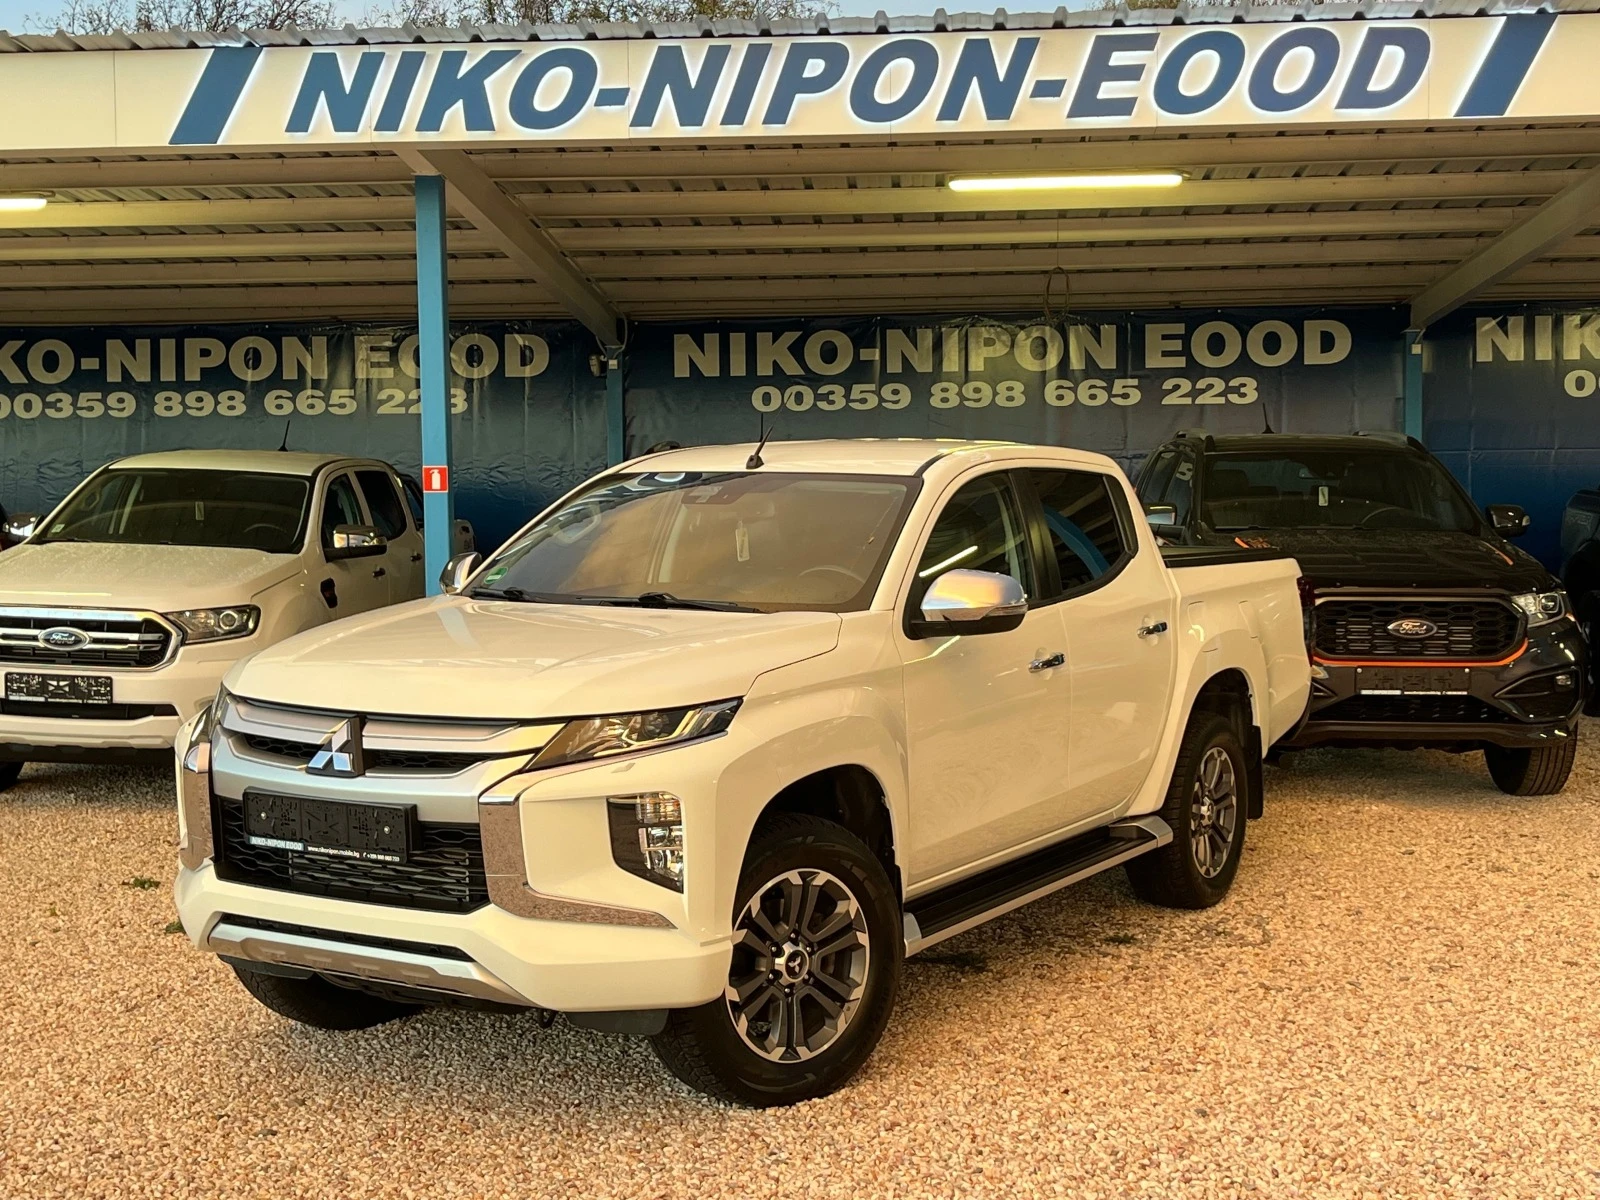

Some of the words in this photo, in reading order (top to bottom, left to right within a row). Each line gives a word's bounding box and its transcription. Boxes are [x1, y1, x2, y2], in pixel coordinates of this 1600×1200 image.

[285, 26, 1431, 133] NIKO-NIPON-EOOD
[673, 323, 1117, 378] NIKO-NIPON
[1144, 319, 1353, 369] EOOD
[1475, 313, 1600, 363] NIK
[153, 390, 247, 418] 898
[263, 388, 358, 416] 665
[751, 383, 912, 413] 00359
[929, 381, 1026, 409] 898
[1043, 378, 1142, 408] 665
[1161, 376, 1259, 406] 223
[49, 632, 75, 644] Ford
[1400, 621, 1427, 634] Ford
